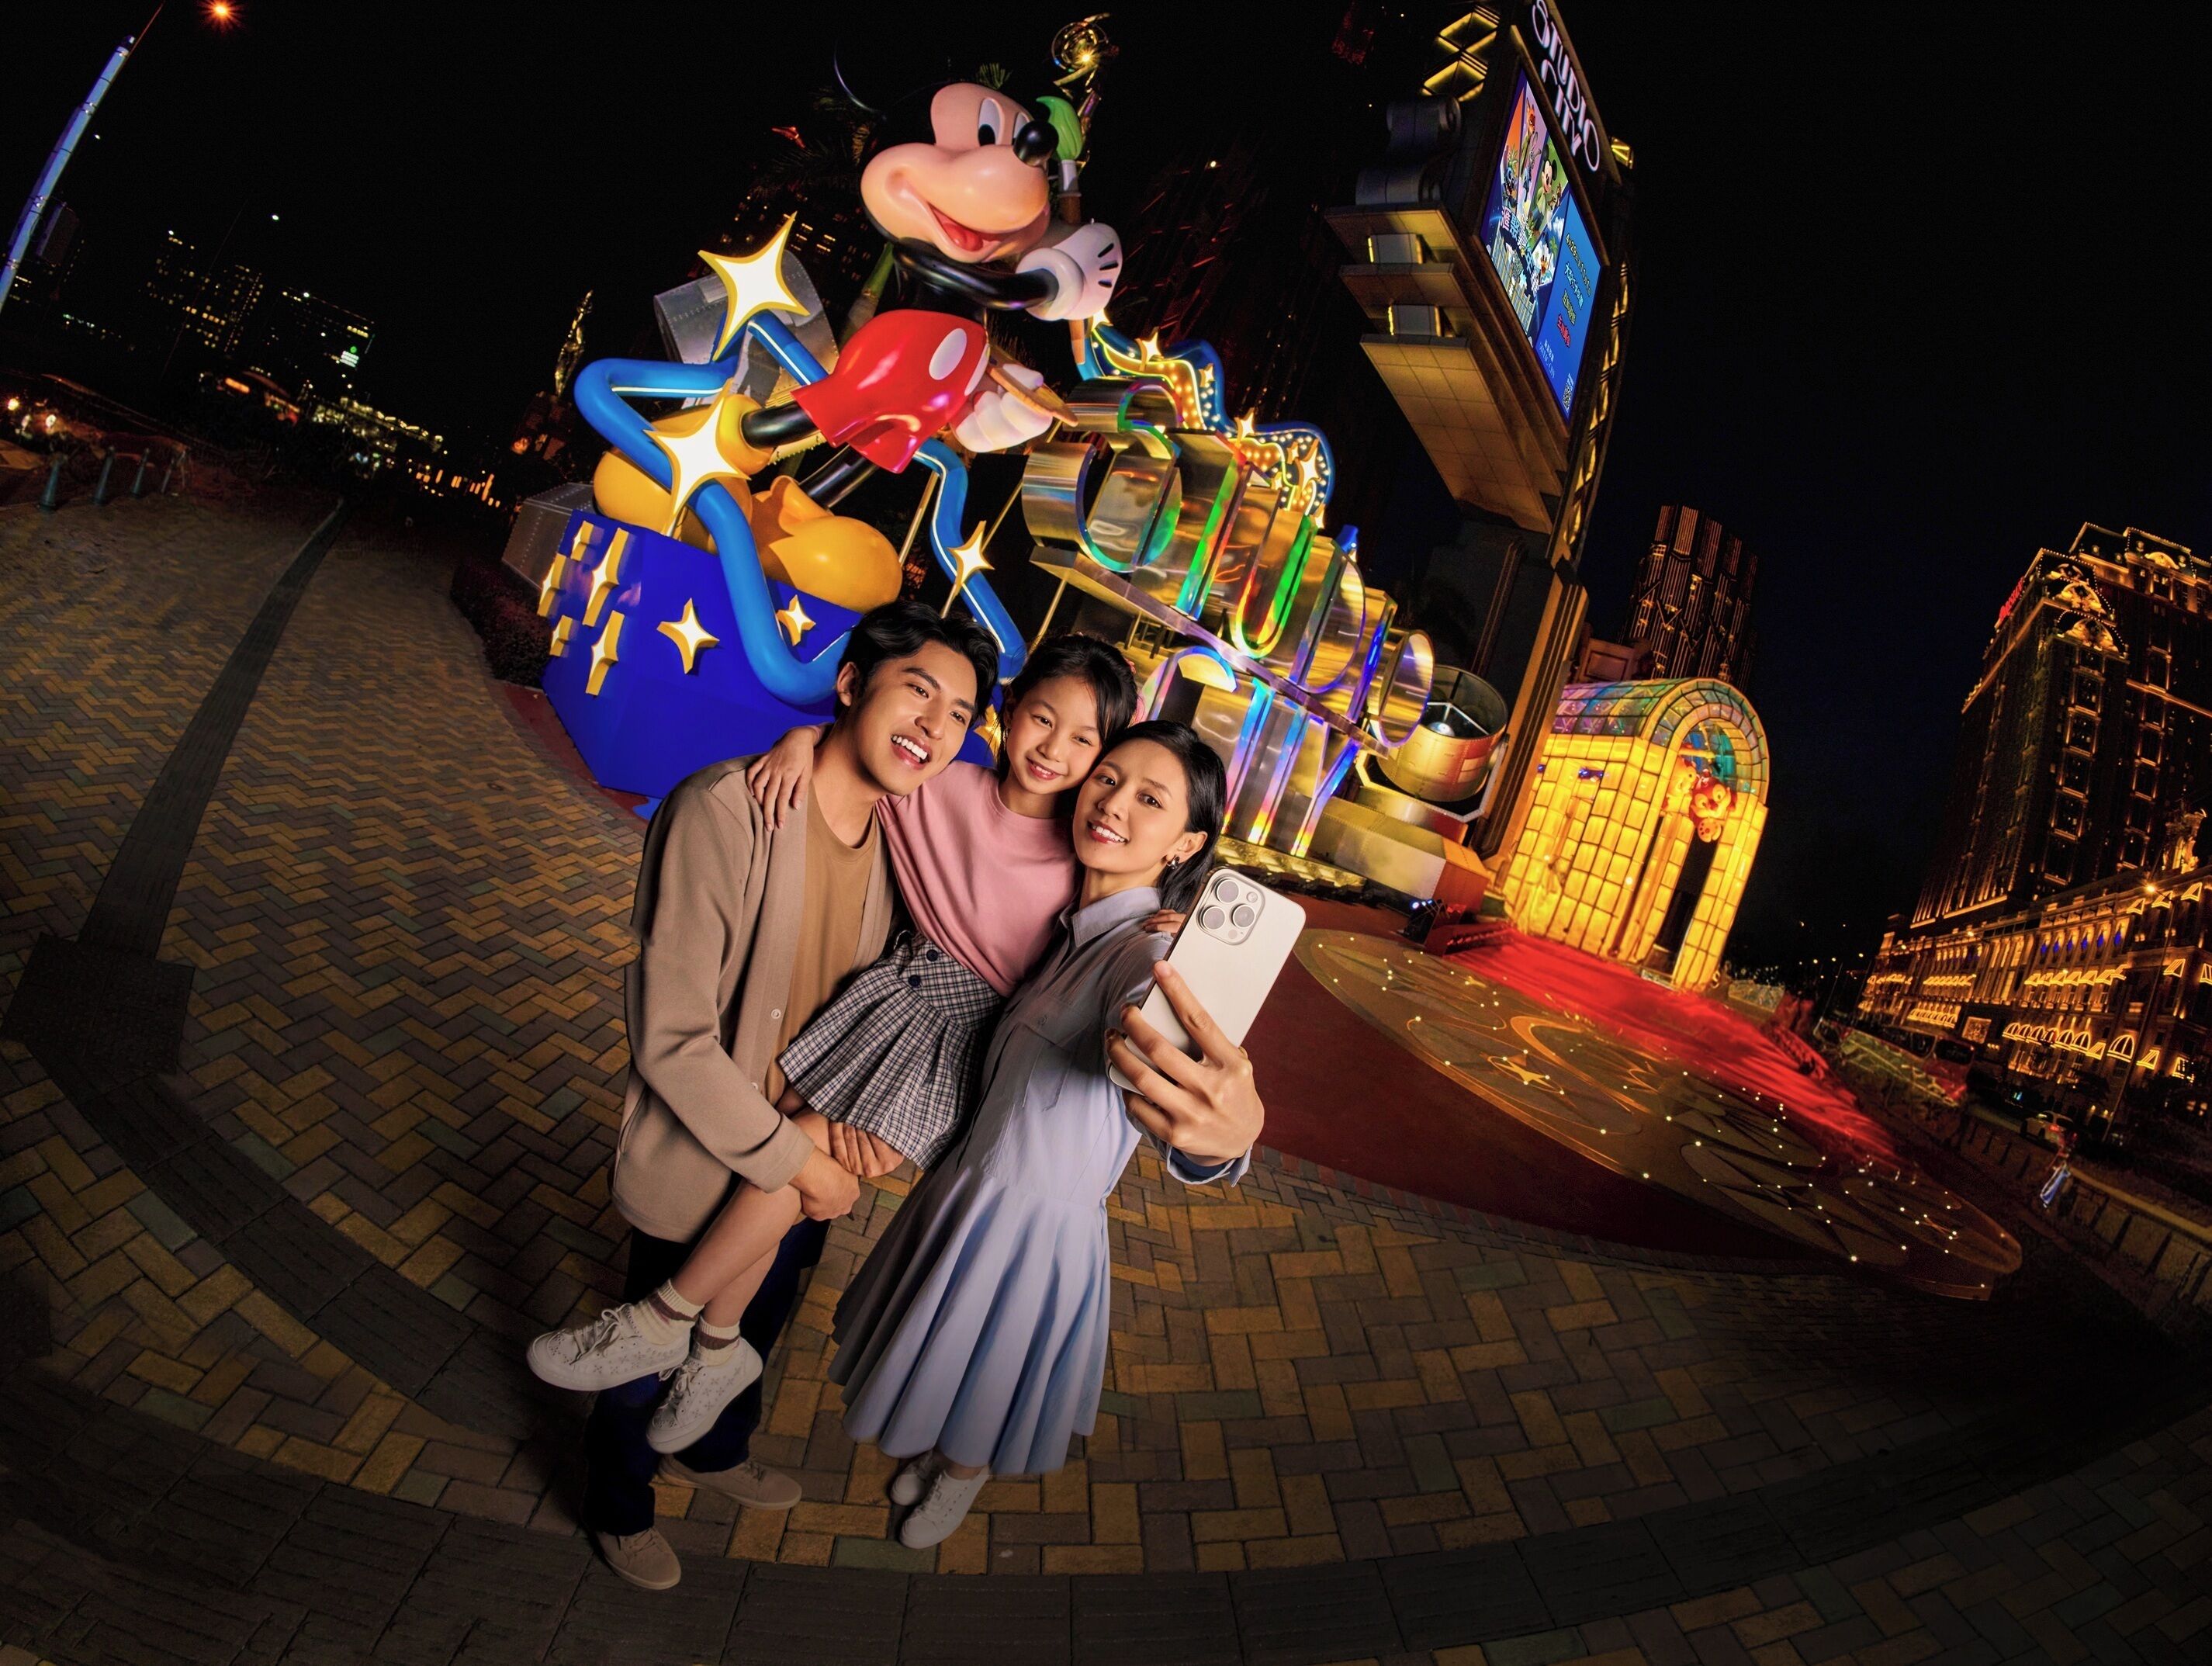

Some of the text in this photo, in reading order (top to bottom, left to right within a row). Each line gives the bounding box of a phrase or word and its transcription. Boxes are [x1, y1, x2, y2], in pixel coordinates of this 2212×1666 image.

[1532, 0, 1600, 171] STUDIO
[1541, 59, 1582, 157] CITY
[1055, 378, 1435, 749] STUDIO
